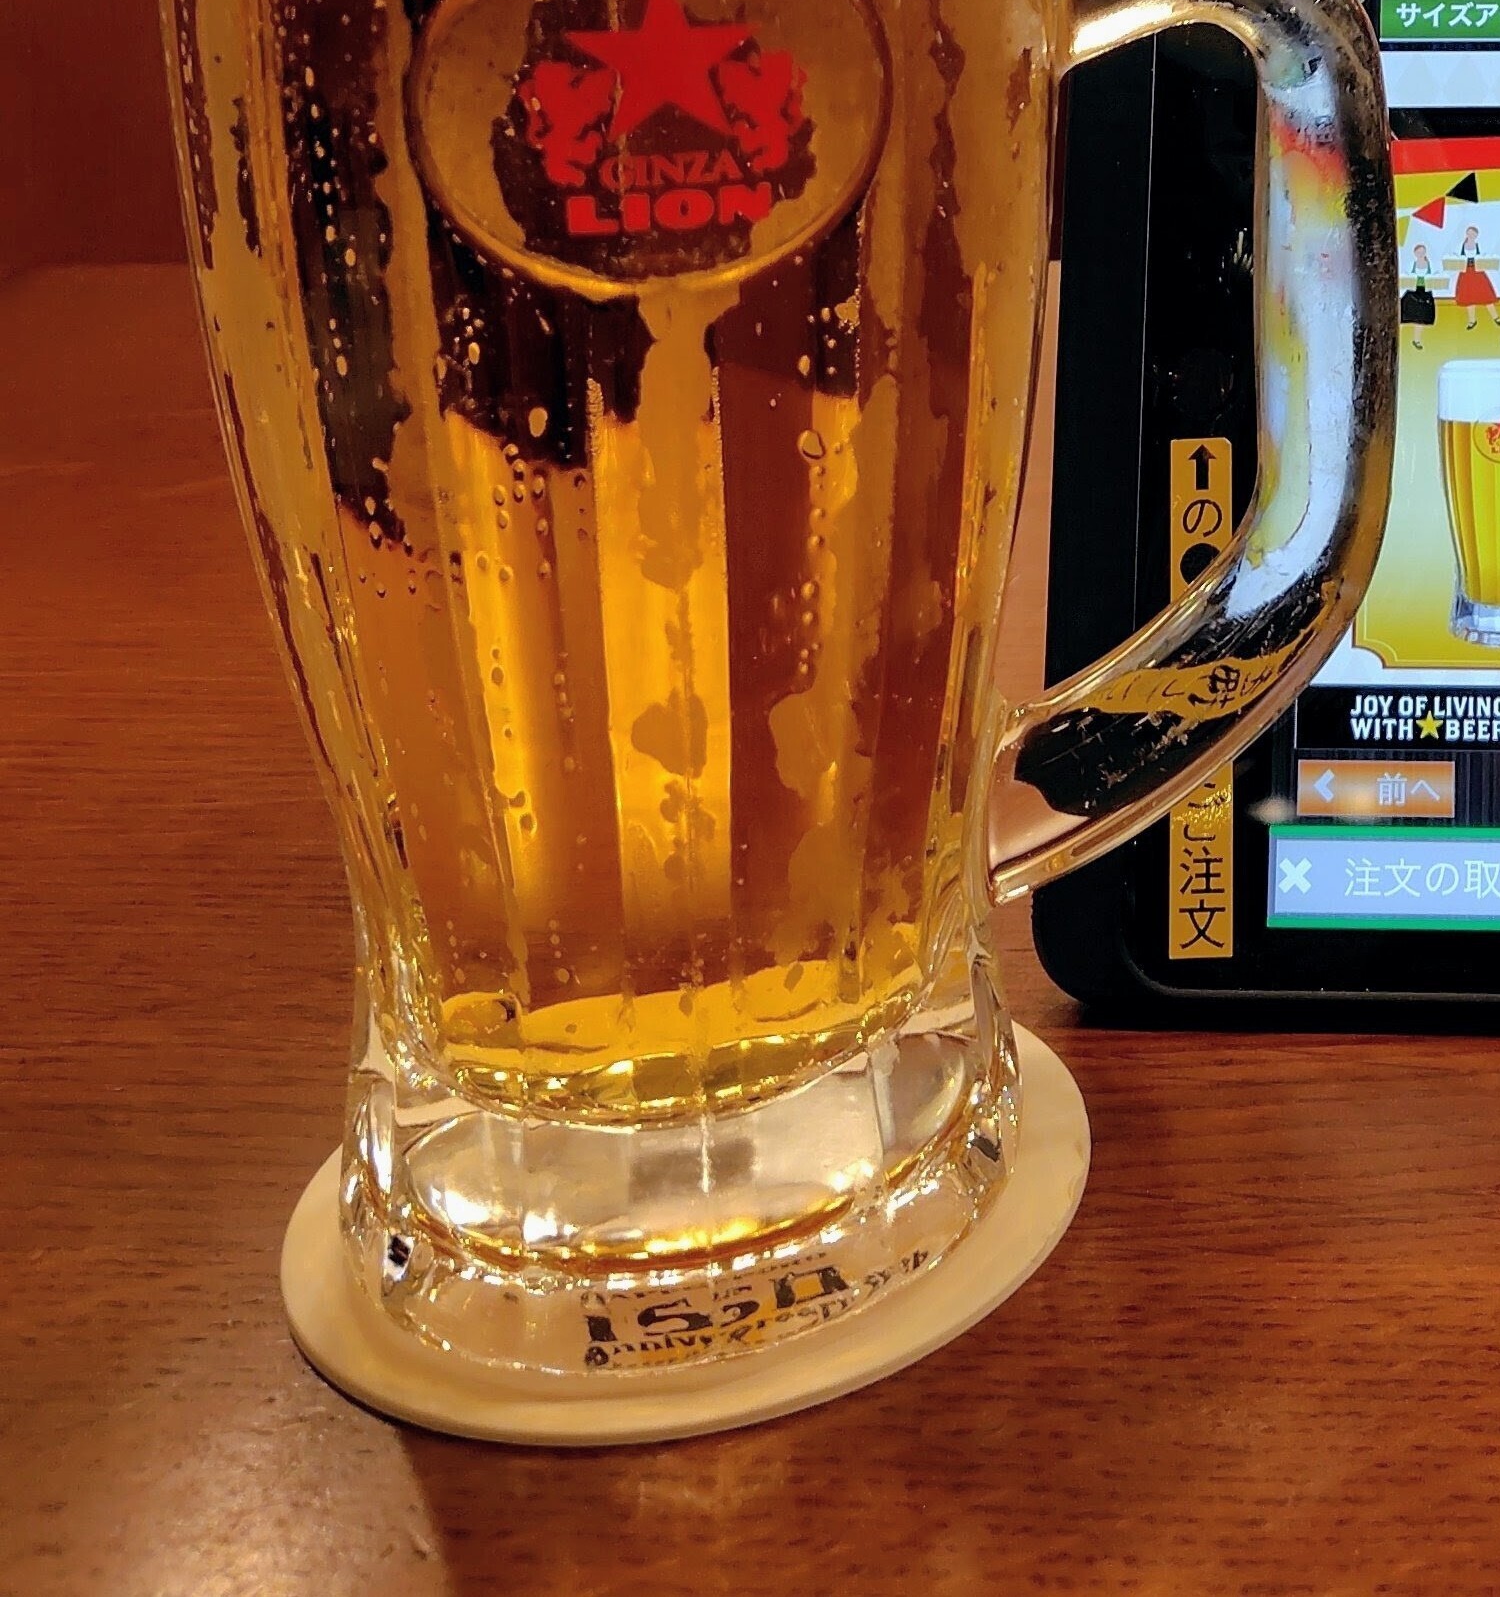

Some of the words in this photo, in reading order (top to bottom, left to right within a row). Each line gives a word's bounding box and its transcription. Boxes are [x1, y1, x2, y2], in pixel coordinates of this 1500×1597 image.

[602, 150, 744, 191] GINZA
[567, 182, 773, 235] LION
[1350, 695, 1394, 718] JOY
[1398, 695, 1429, 718] OF
[1350, 718, 1414, 741] WITH
[1376, 772, 1441, 806] 前へ
